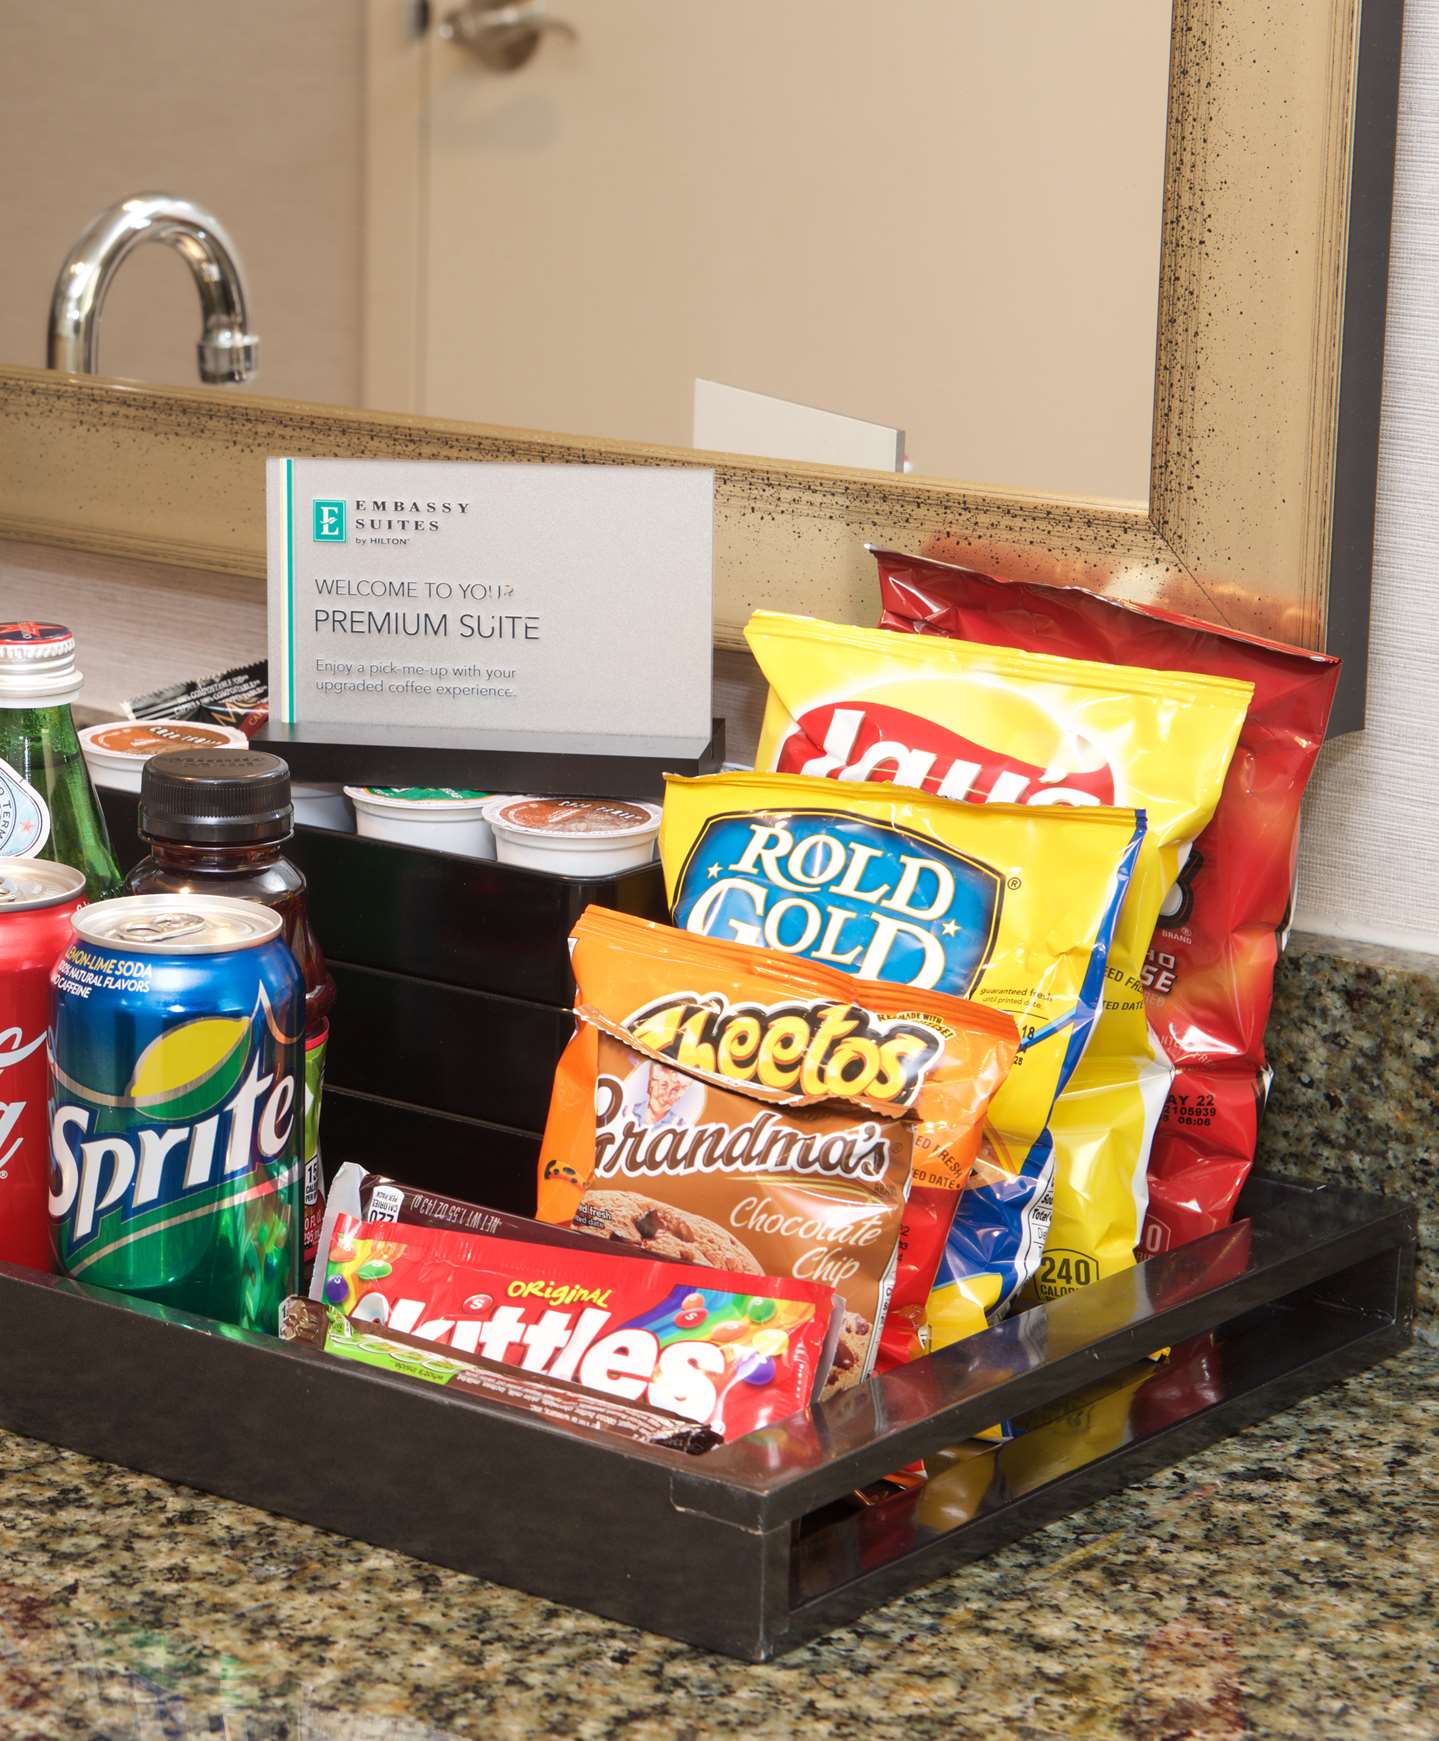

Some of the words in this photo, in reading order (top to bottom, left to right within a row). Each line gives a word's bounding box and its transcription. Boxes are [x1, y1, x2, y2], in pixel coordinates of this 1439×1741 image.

[355, 500, 470, 514] EMBASSY
[355, 518, 440, 532] SUITES
[355, 538, 367, 546] by
[315, 579, 419, 598] WELCOME
[424, 582, 452, 599] TO
[315, 609, 448, 637] PREMIUM
[460, 614, 540, 640] SUITE
[316, 659, 353, 676] Enjoy
[357, 665, 365, 673] a
[369, 662, 448, 680] pick-me-up
[452, 664, 481, 677] with
[486, 669, 516, 681] your
[316, 680, 384, 696] upgraded
[388, 681, 432, 695] coffee
[728, 823, 956, 922] ROLD
[686, 877, 946, 991] GOLD
[115, 959, 153, 978] SODA
[58, 976, 92, 998] CAFFEINE
[69, 966, 102, 987] NATURAL
[103, 976, 150, 993] FLAVORS
[980, 987, 1027, 997] guaranteed
[997, 998, 1022, 1006] printed
[1022, 1025, 1035, 1040] 18
[1168, 1094, 1189, 1106] AY
[1196, 1094, 1215, 1106] 22
[594, 1076, 890, 1177] Grandma's
[47, 1050, 295, 1241] Sprite
[928, 1173, 954, 1189] DATE
[435, 1201, 448, 1219] OZ
[448, 1205, 467, 1225] 1.55
[465, 1211, 482, 1229] WT
[480, 1214, 500, 1234] NET
[730, 1196, 882, 1247] Chocolate
[792, 1247, 859, 1288] Chip
[1040, 1256, 1090, 1286] 240
[349, 1291, 726, 1426] kittles
